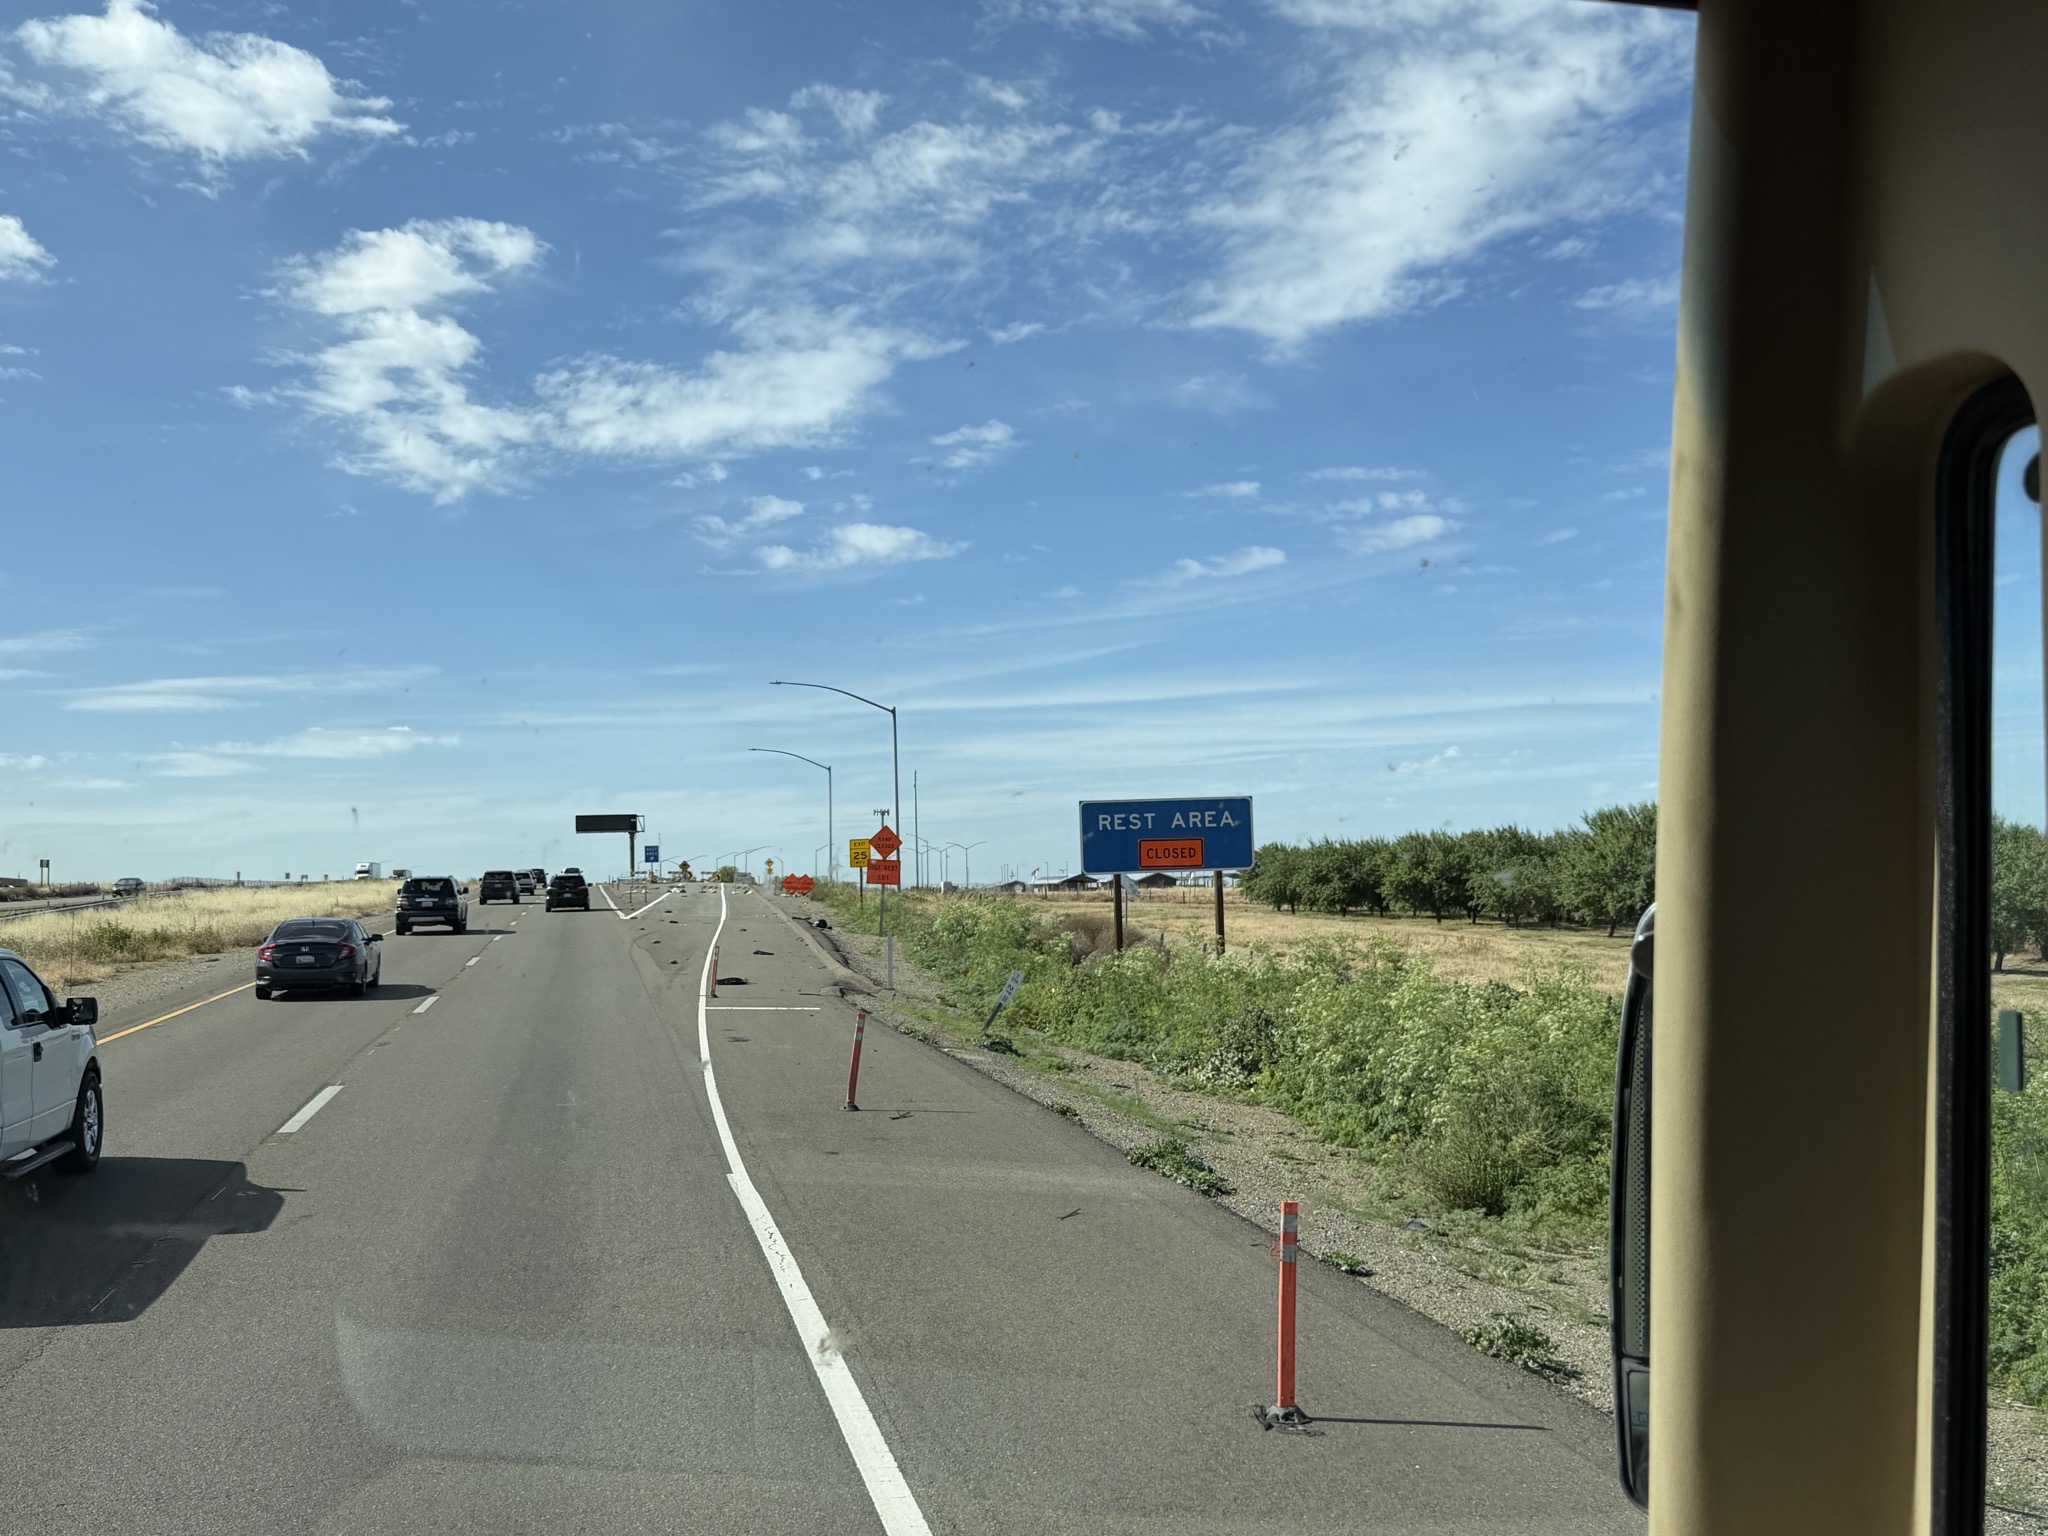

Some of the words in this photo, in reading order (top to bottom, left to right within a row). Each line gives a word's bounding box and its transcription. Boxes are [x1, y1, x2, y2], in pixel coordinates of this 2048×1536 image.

[1098, 813, 1156, 830] REST
[1171, 810, 1235, 828] AREA
[1146, 848, 1196, 860] CLOSED
